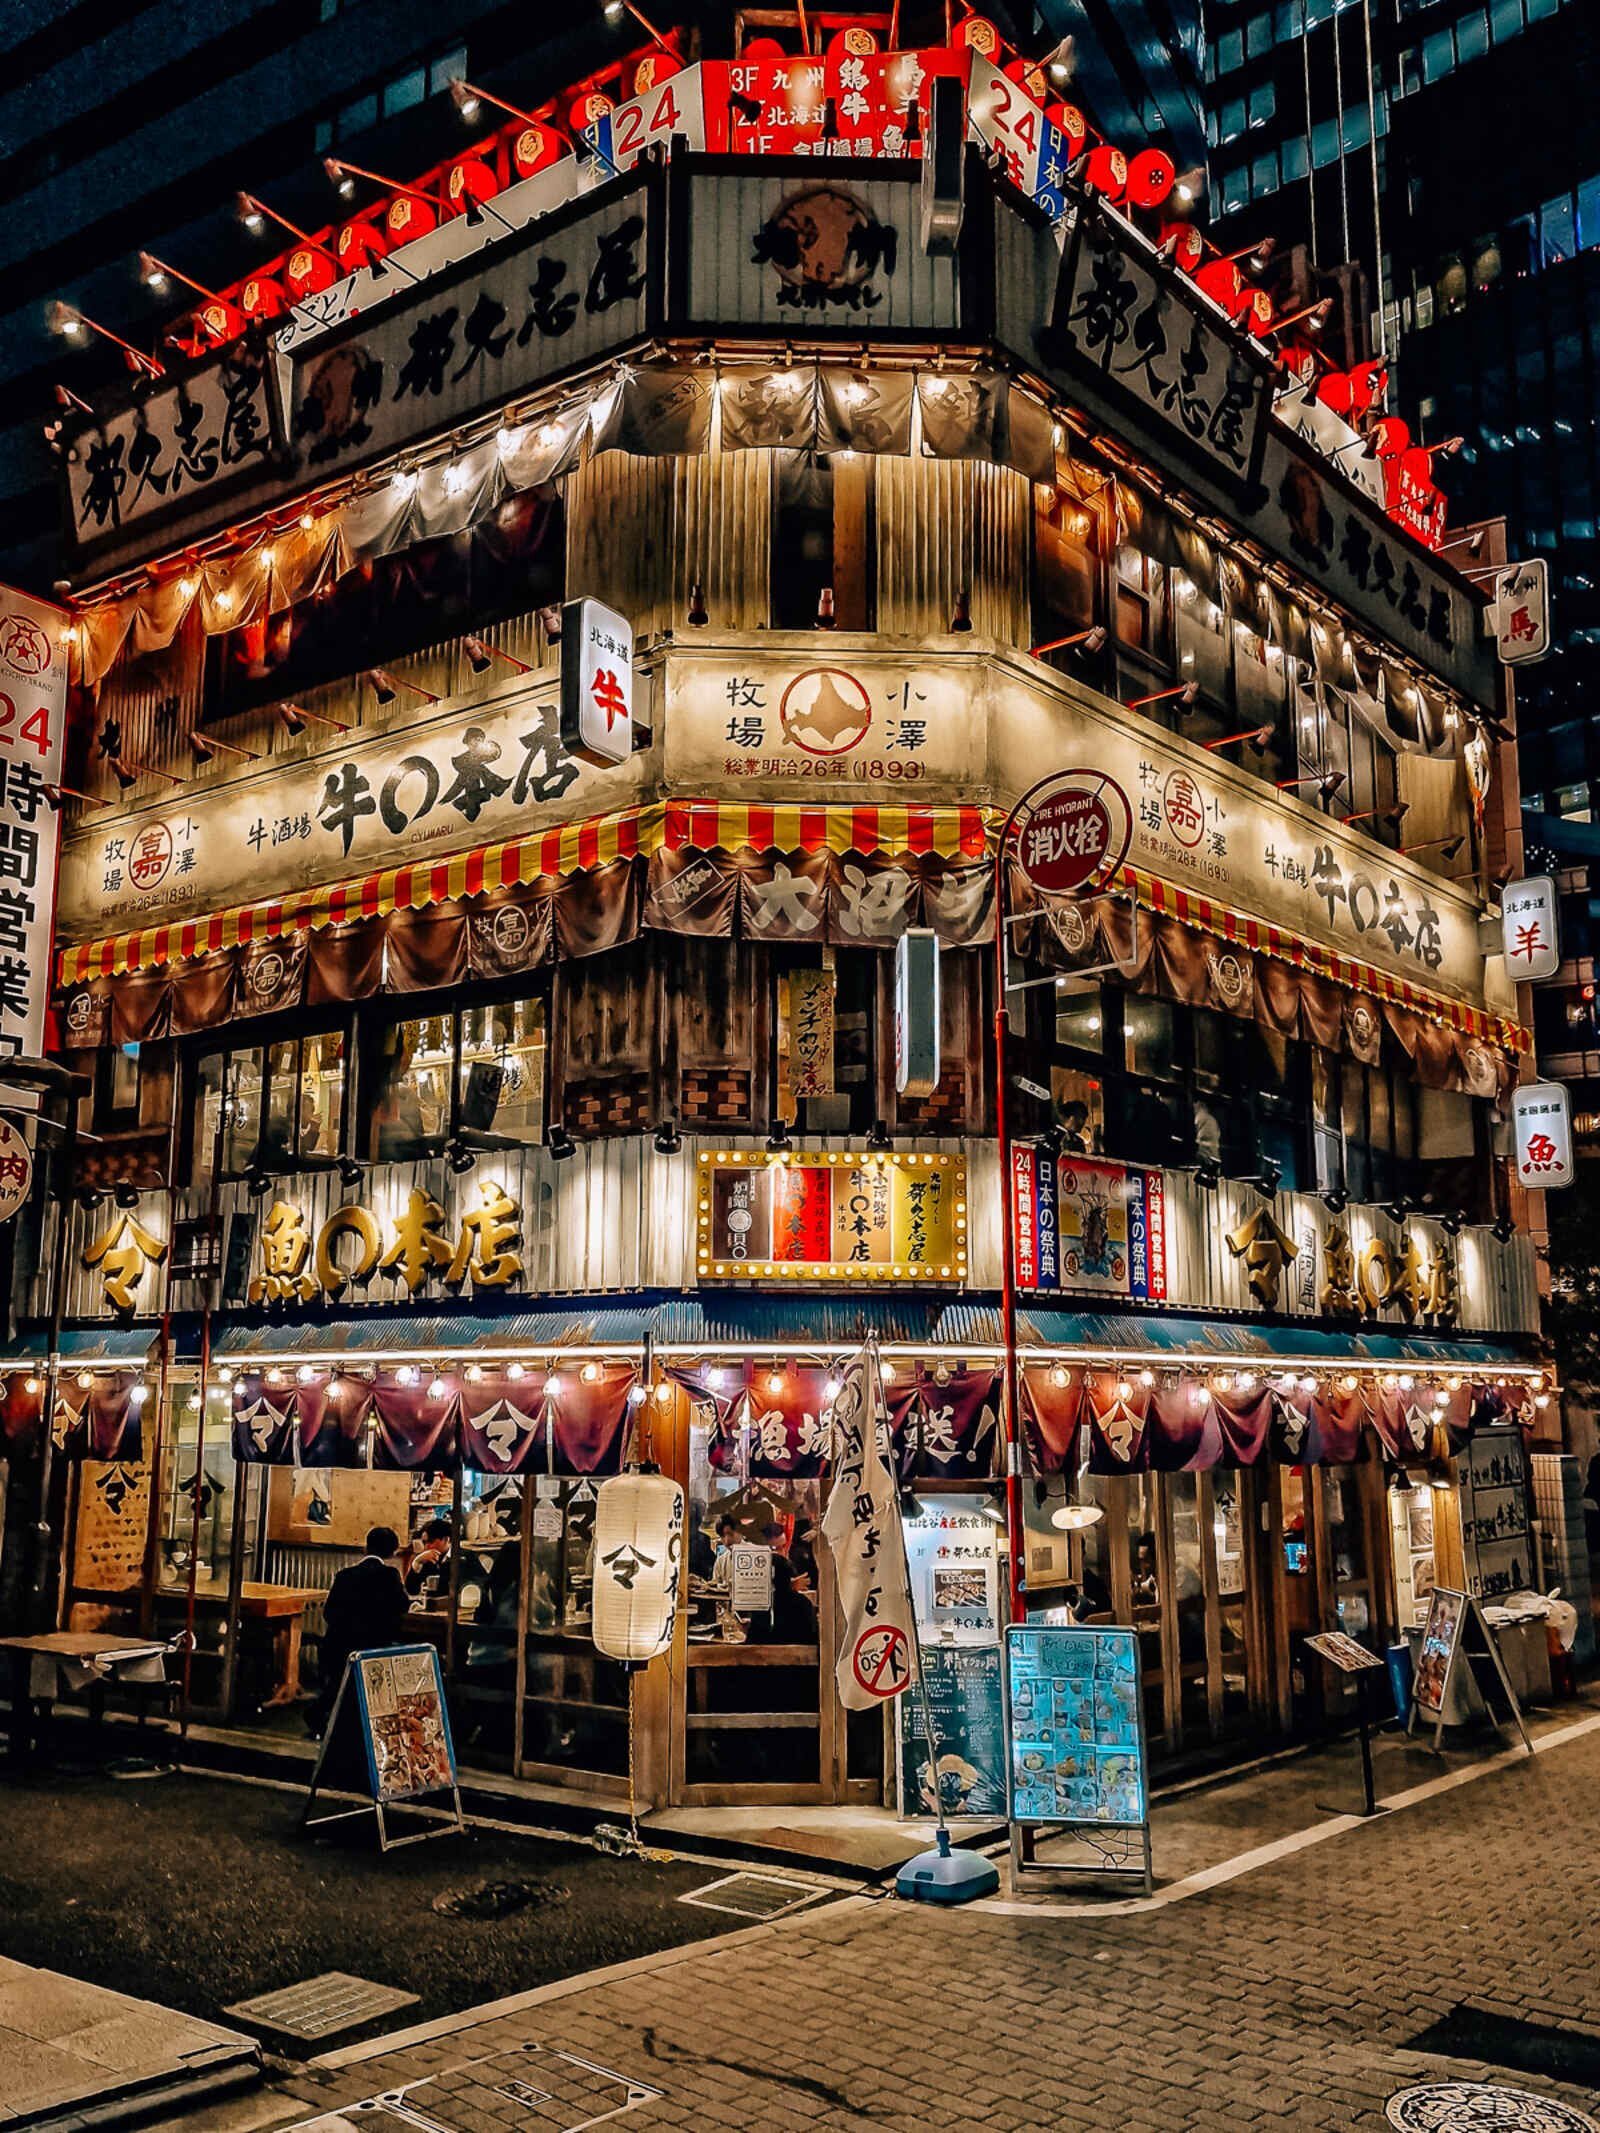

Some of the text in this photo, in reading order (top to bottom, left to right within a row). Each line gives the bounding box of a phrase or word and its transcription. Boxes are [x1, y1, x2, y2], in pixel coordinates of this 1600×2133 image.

[731, 67, 759, 91] 3F
[615, 85, 681, 155] 24
[990, 79, 1038, 155] 24
[590, 626, 630, 664] 北海道
[1502, 605, 1541, 643] 馬
[590, 667, 629, 733] 牛
[725, 677, 767, 748] 牧場
[885, 681, 928, 751] 小澤
[246, 812, 314, 855] 牛酒場
[1034, 796, 1095, 822] FIRE HYDRANT
[102, 839, 126, 892] 牧場
[1027, 813, 1104, 868] 消火栓
[1264, 843, 1309, 889] 牛酒場
[1505, 897, 1546, 914] 北海道
[1509, 921, 1549, 964] 羊
[1522, 1133, 1564, 1174] 魚
[1015, 1152, 1033, 1282] 24時間営業中
[1039, 1160, 1056, 1278] 日本の祭典
[1131, 1176, 1147, 1287] 日本の祭典
[1148, 1176, 1165, 1294] 24時間営業中
